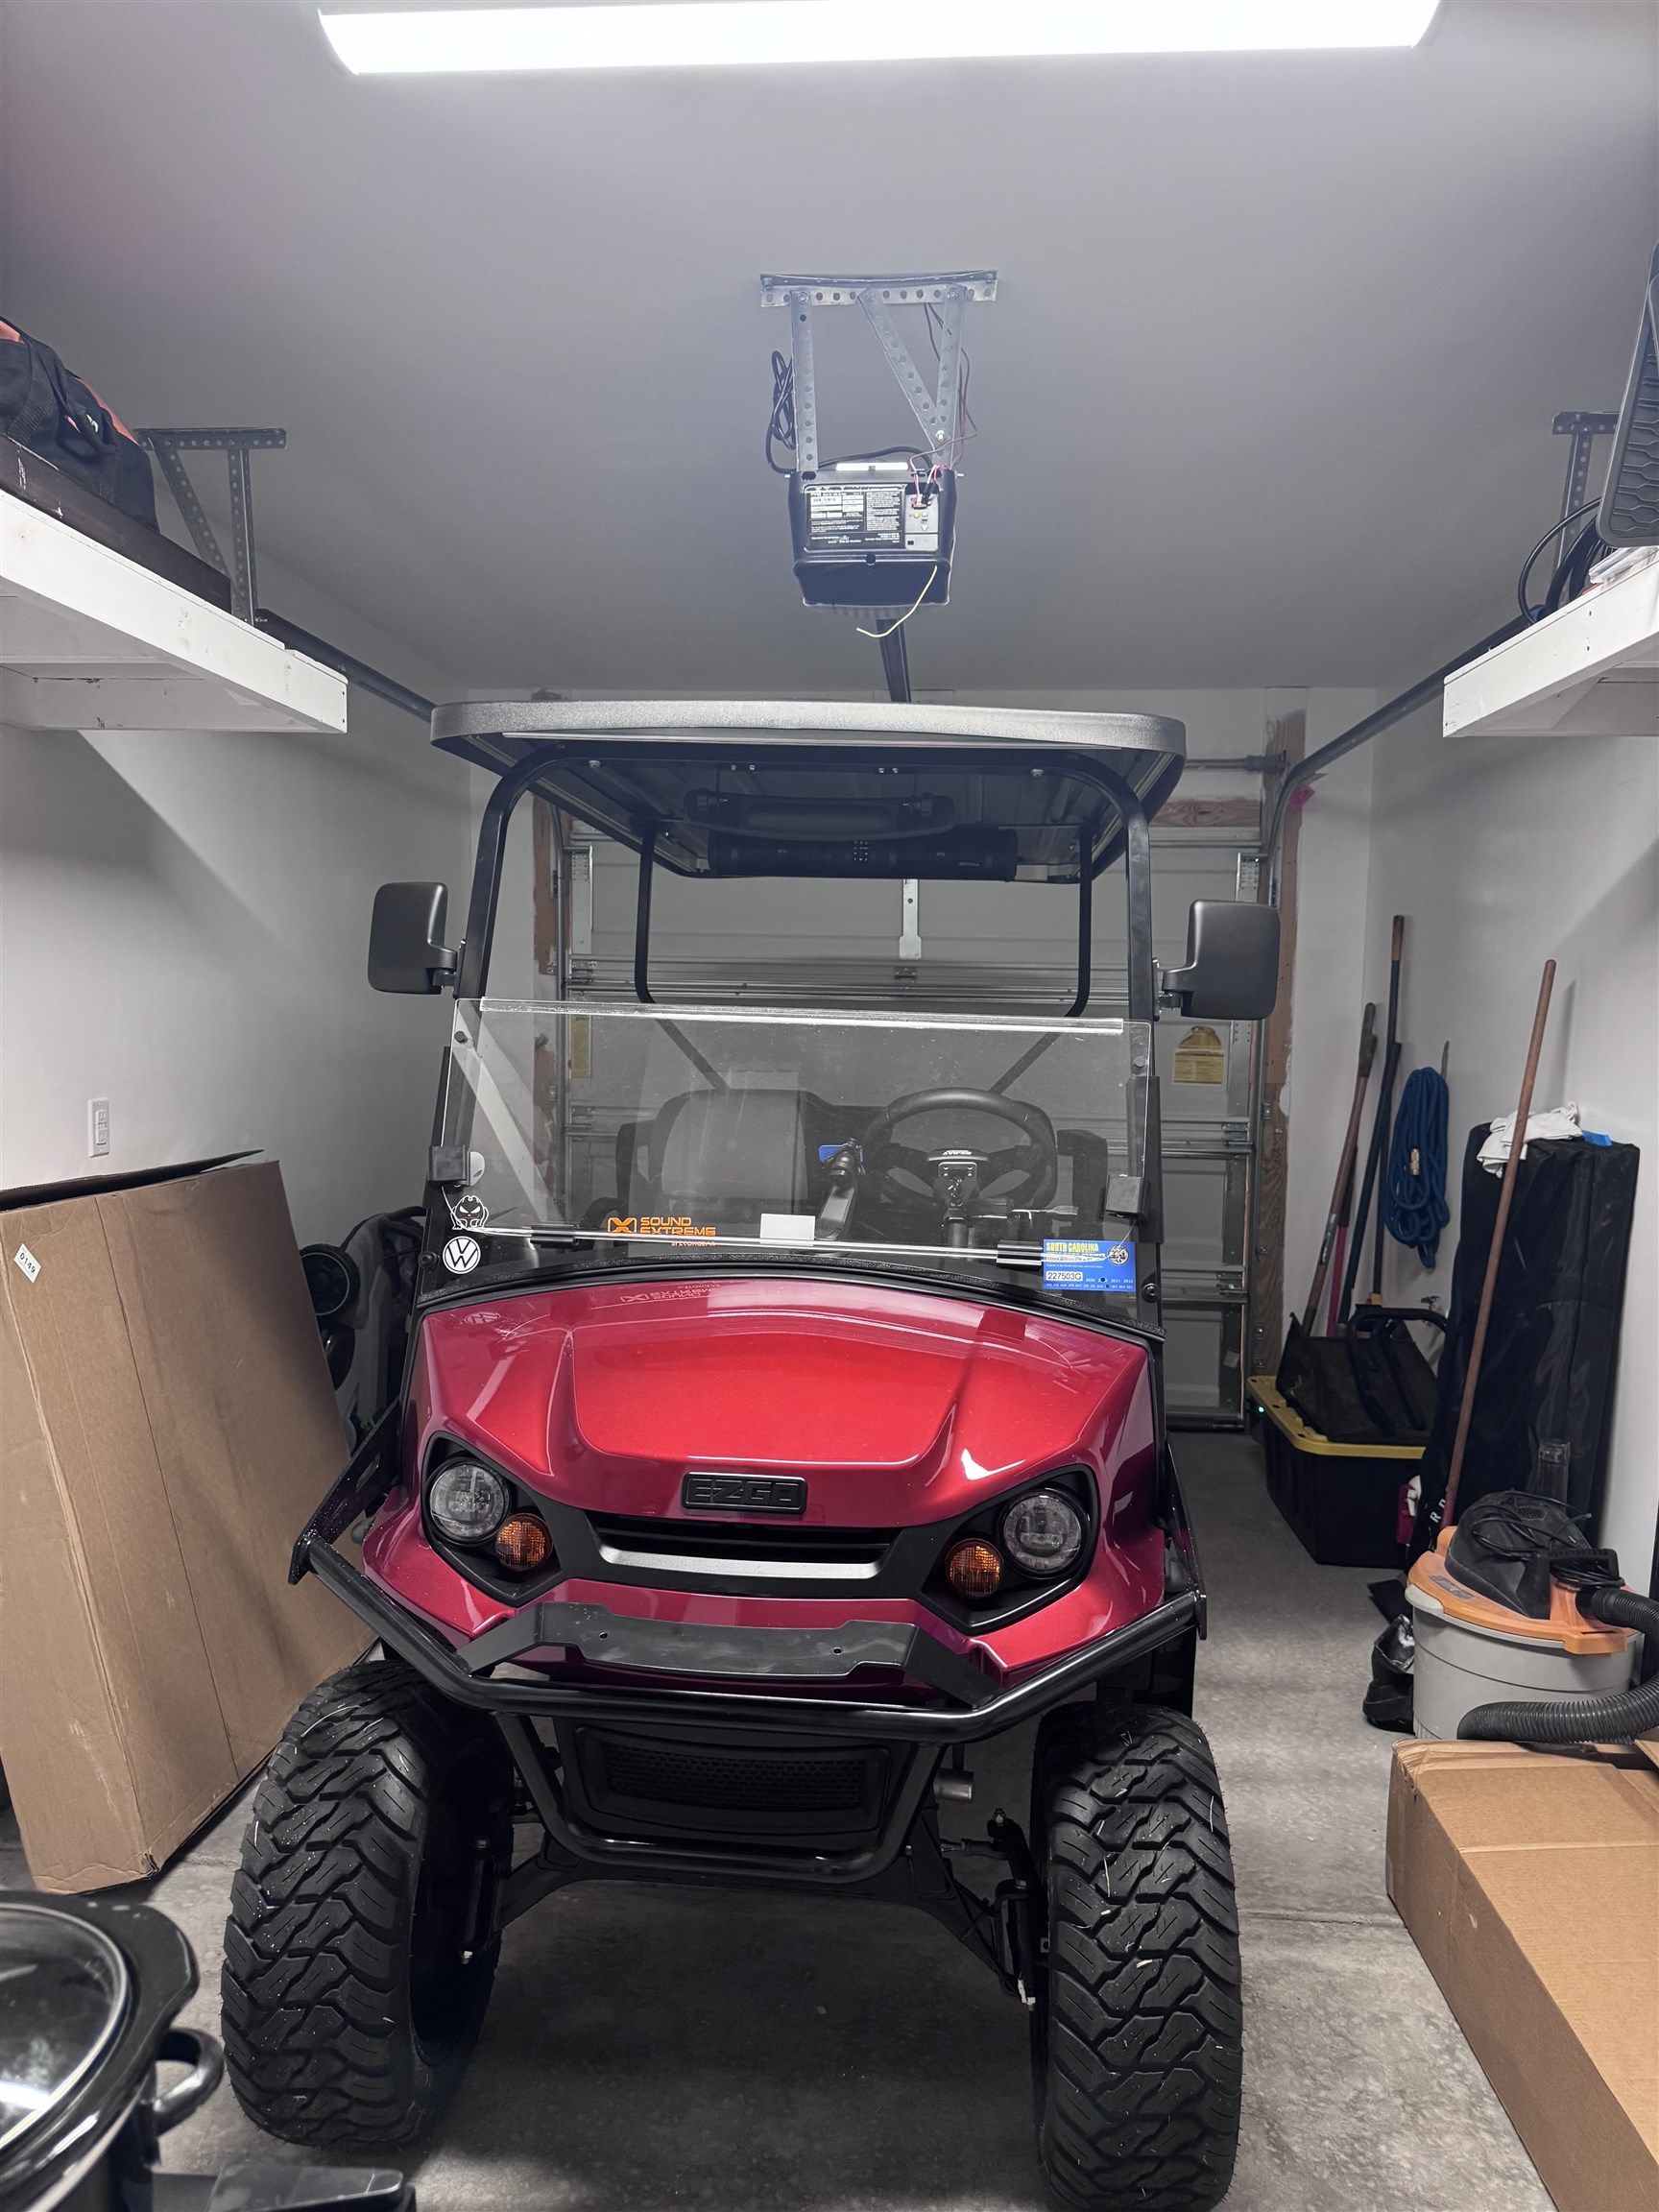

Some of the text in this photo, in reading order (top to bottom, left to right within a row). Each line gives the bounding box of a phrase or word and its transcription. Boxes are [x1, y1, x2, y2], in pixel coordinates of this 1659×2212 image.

[639, 1216, 692, 1227] SOUND
[639, 1226, 716, 1237] EXTREME
[1046, 1242, 1098, 1252] SOUTH CAROLINA
[19, 1253, 36, 1273] 0149
[1047, 1272, 1082, 1281] 227503G
